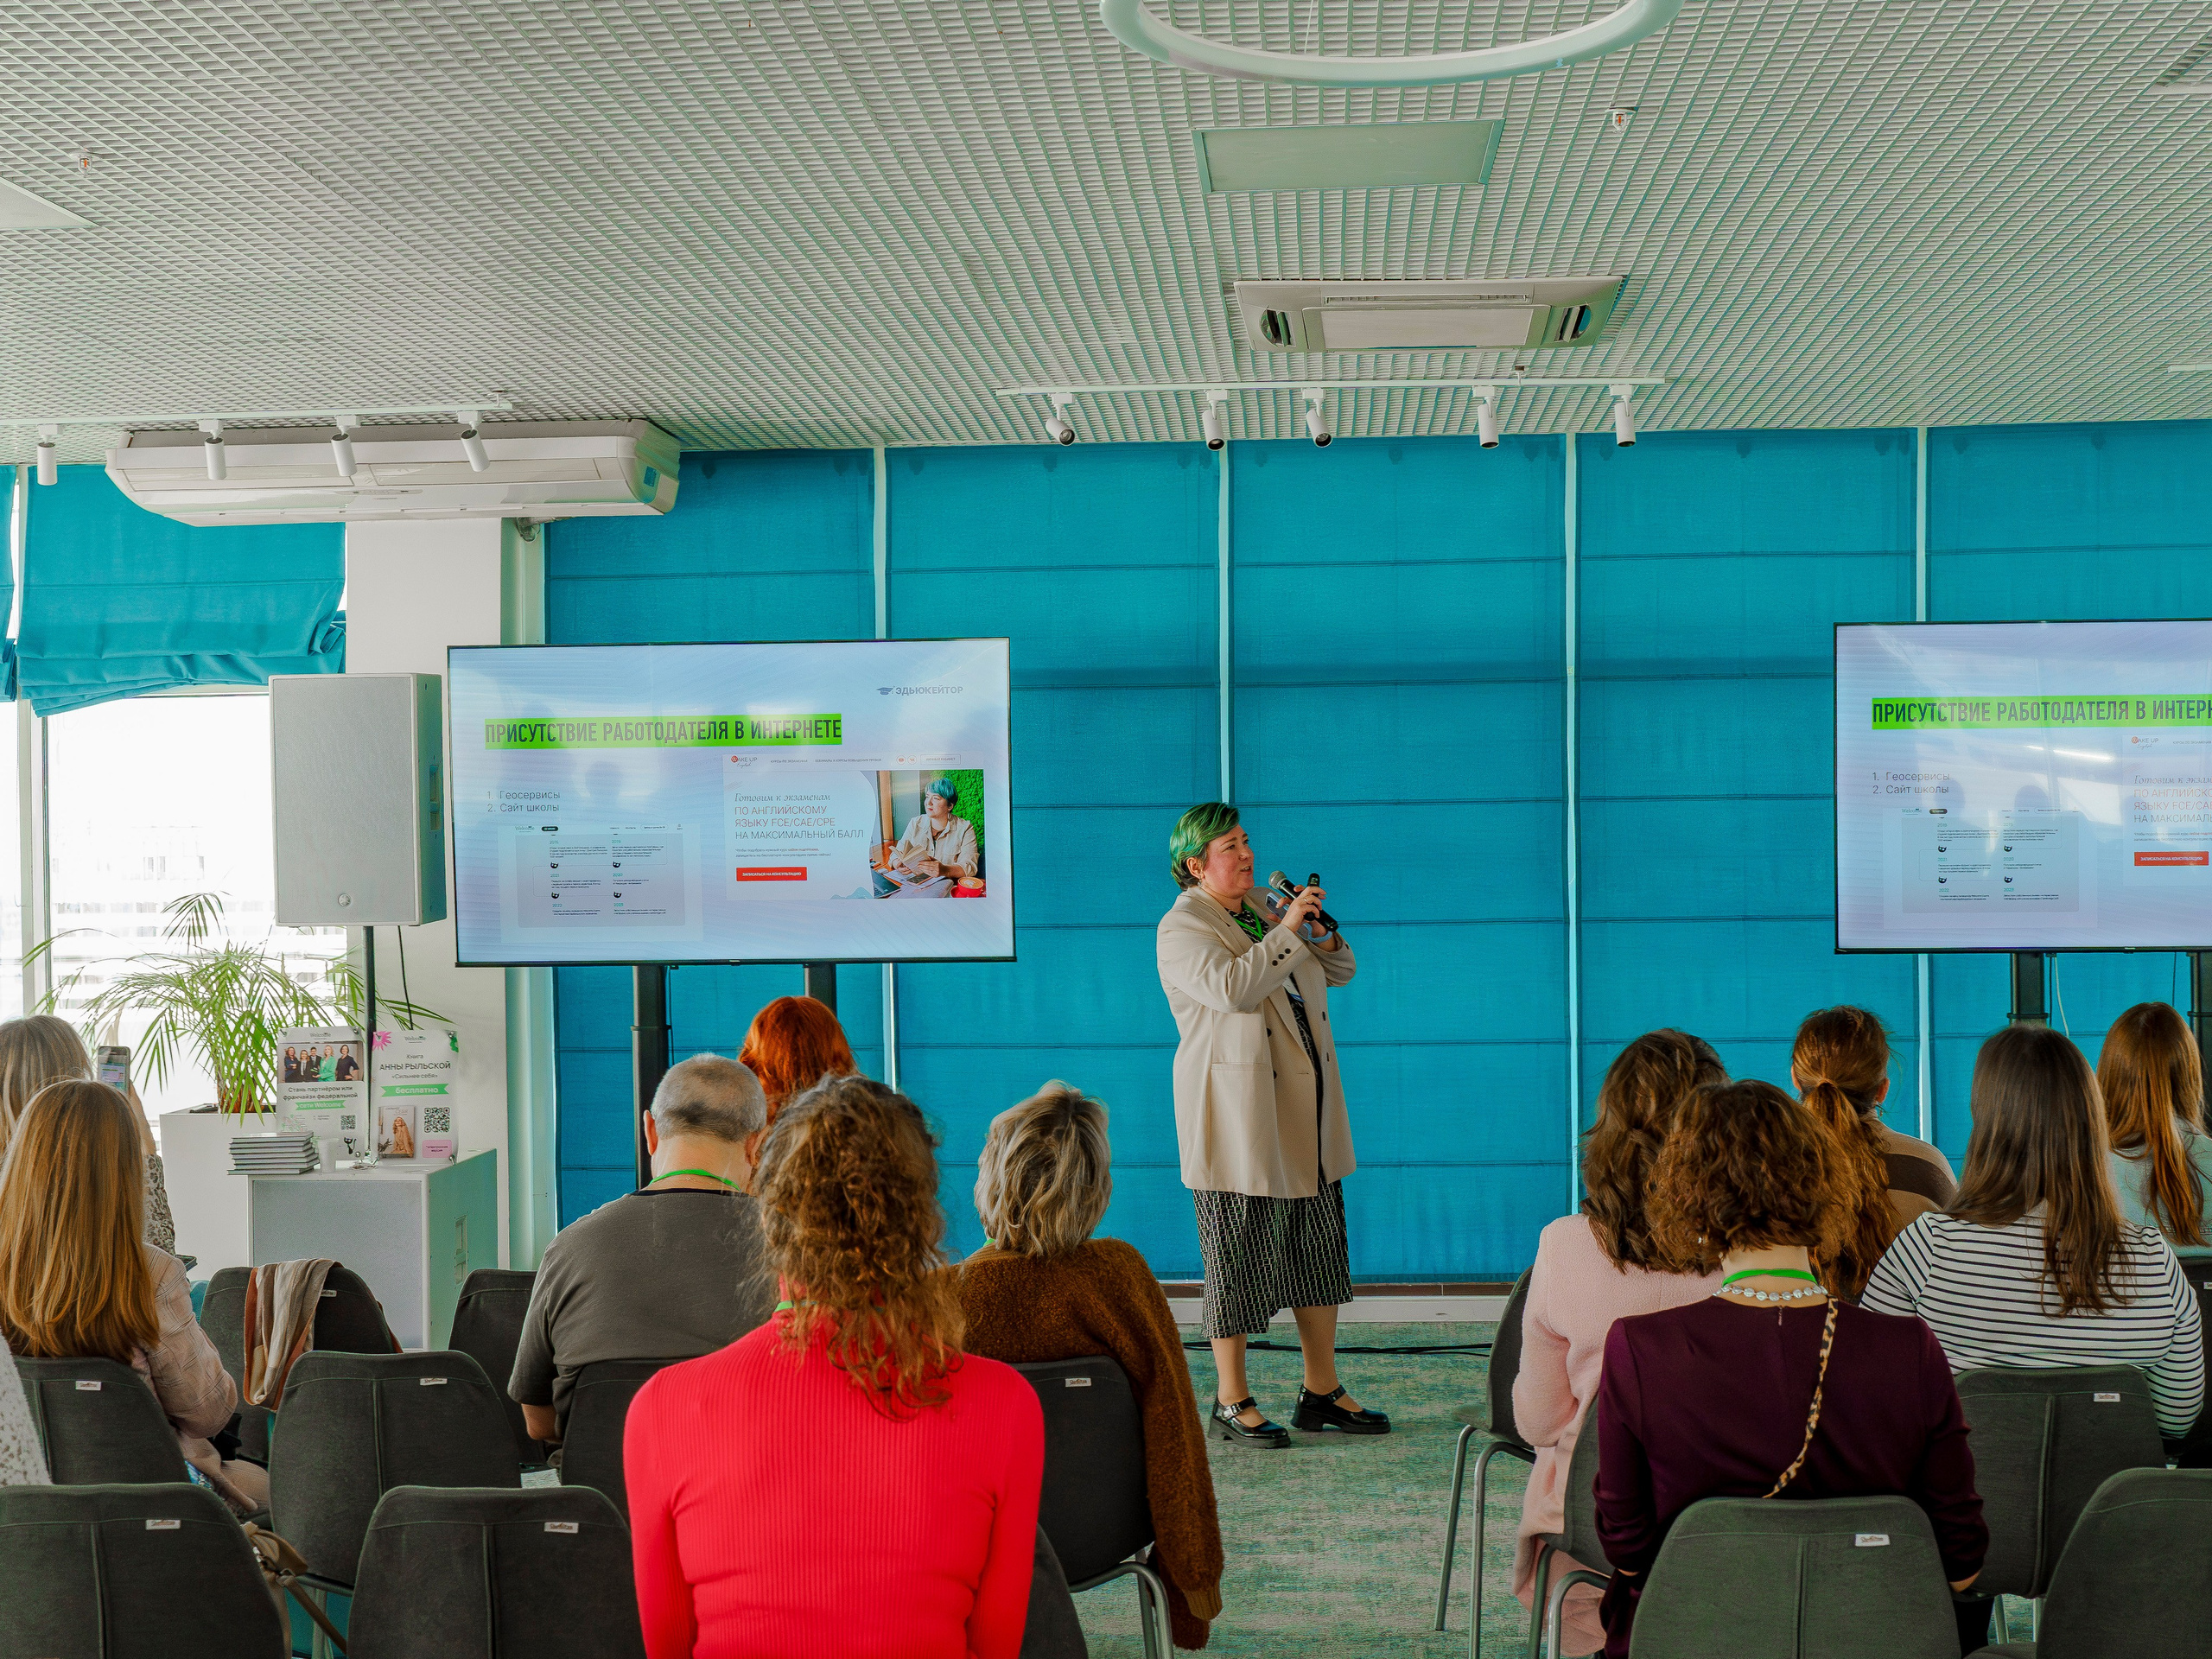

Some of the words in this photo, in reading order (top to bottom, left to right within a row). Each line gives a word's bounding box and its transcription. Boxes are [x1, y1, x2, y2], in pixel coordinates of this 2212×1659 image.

[895, 685, 963, 696] ЭДЬЮКЕЙТОР
[1872, 702, 1991, 722] ПРИСУТСТВИЕ
[1997, 701, 2129, 724] РАБОТОДАТЕЛЯ
[2136, 701, 2145, 720] В
[486, 722, 597, 743] ПРИСУТСТВИЕ
[602, 721, 728, 744] РАБОТОДАТЕЛЯ
[734, 720, 744, 740] В
[750, 719, 842, 740] ИНТЕРНЕТЕ
[1872, 772, 1879, 781] 1.
[1885, 772, 1950, 782] Геосервисы
[2134, 775, 2175, 785] Готовим
[1872, 785, 1882, 794] 2.
[1885, 785, 1911, 794] Сайт
[1914, 785, 1949, 794] школы
[2134, 788, 2149, 798] ПО
[499, 791, 561, 800] Геосервисы
[734, 792, 773, 802] Готовим
[784, 793, 830, 802] экзаменам
[487, 804, 496, 812] 2.
[499, 803, 524, 812] Сайт
[526, 804, 560, 812] школы
[734, 806, 749, 816] ПО
[751, 804, 827, 815] АНГЛИЙСКОМУ
[2134, 801, 2170, 810] ЯЗЫКУ
[734, 818, 769, 828] ЯЗЫКУ
[771, 817, 836, 828] FCE/CAE/CPE
[735, 831, 749, 840] НА
[751, 829, 836, 839] МАКСИМАЛЬНЫЙ
[837, 830, 864, 839] БАЛЛ
[404, 1060, 451, 1071] РЫЛЬСКОЙ
